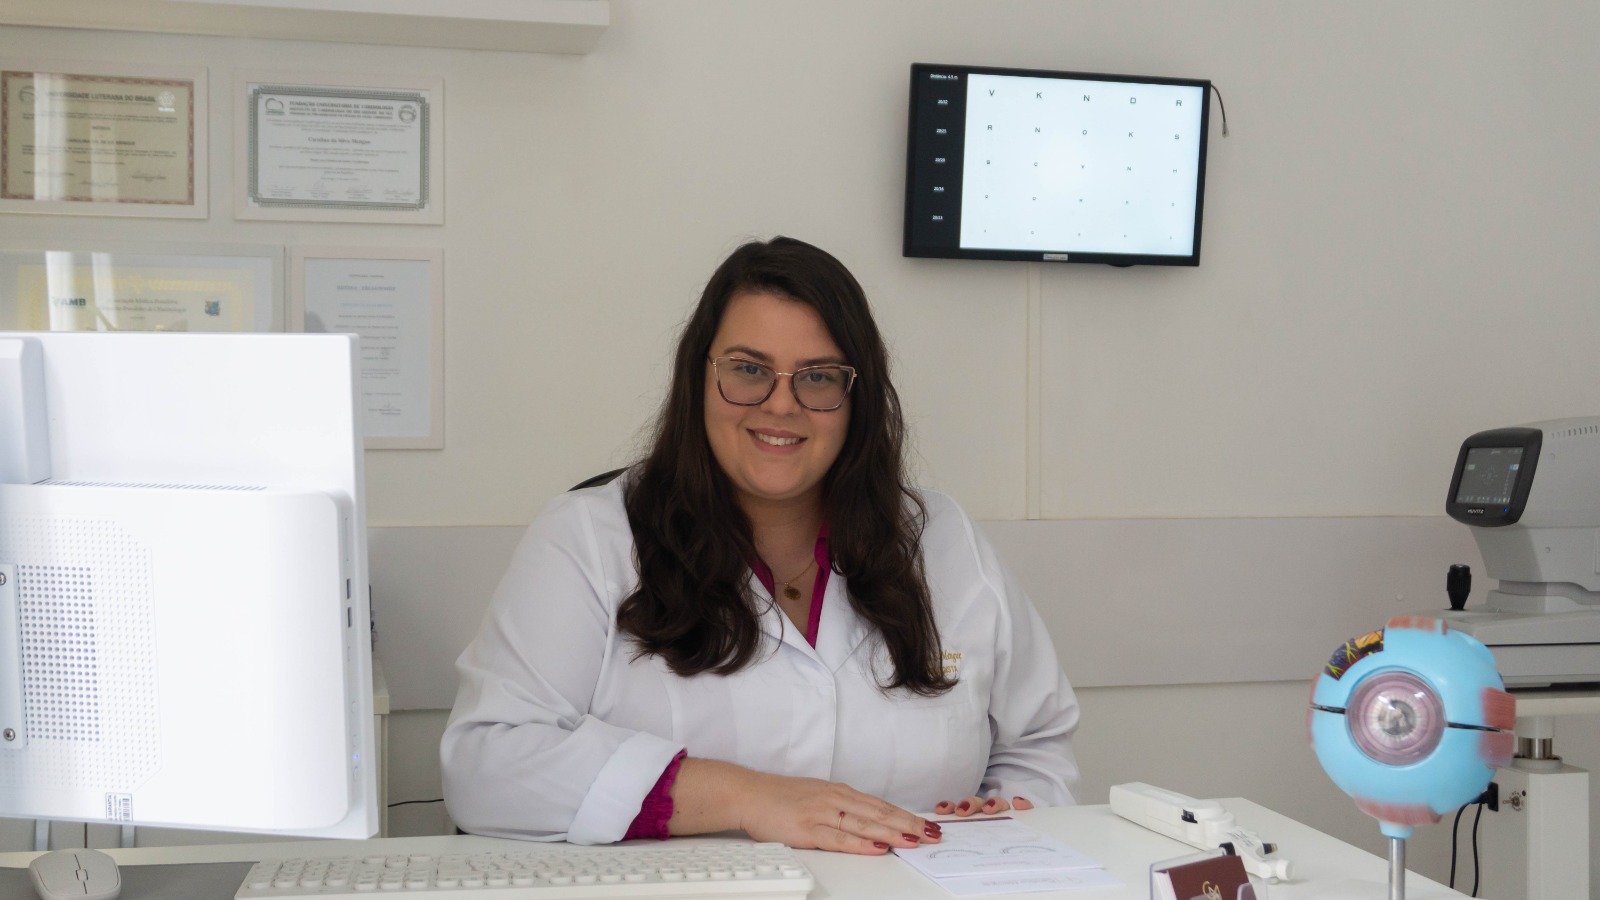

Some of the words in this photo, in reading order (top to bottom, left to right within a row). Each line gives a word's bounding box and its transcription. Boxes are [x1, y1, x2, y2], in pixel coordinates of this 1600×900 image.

[989, 89, 995, 97] V
[1083, 94, 1090, 102] N
[1129, 97, 1136, 105] D
[1176, 99, 1182, 107] R
[60, 298, 86, 306] AMB
